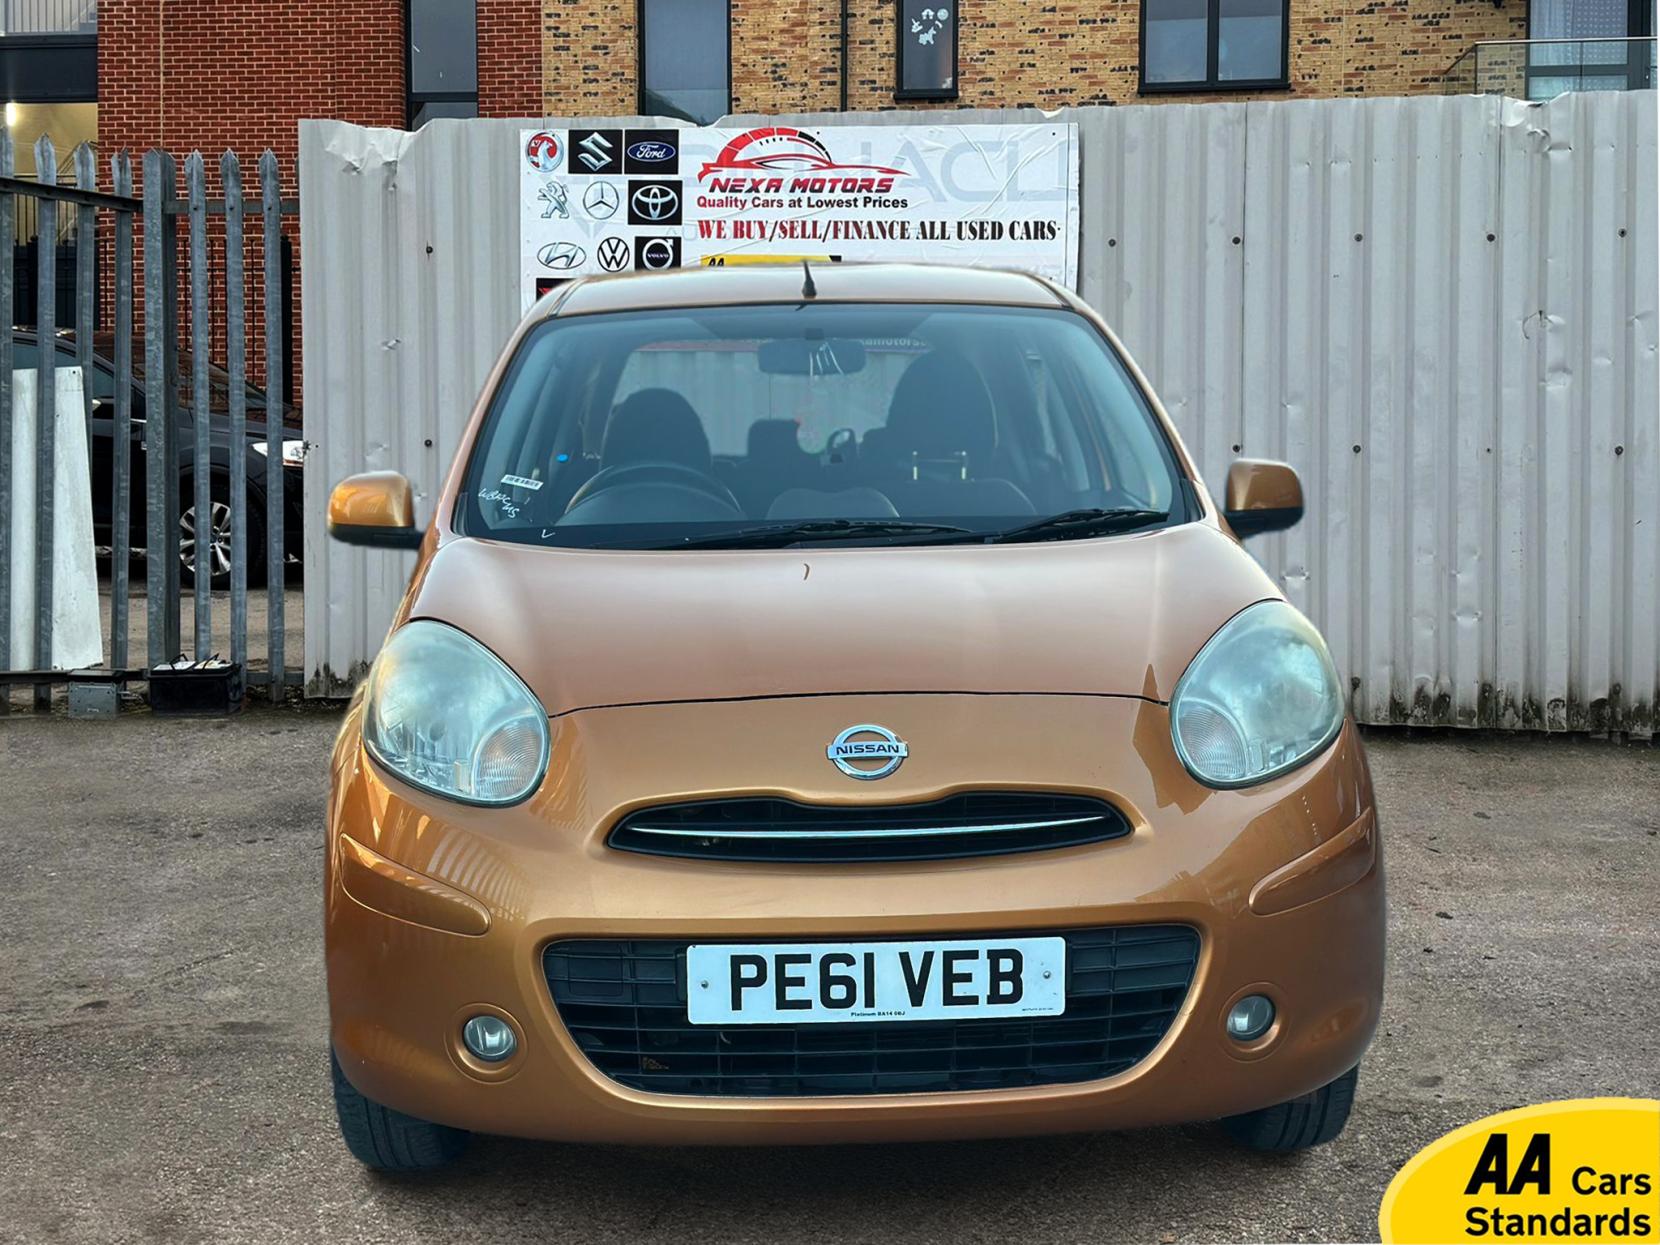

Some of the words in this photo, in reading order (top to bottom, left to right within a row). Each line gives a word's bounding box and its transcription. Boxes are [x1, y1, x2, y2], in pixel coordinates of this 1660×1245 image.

[634, 143, 668, 160] Ford
[708, 178, 783, 193] NEXA
[789, 177, 894, 193] MOTORS
[697, 196, 747, 211] Quality
[752, 196, 784, 209] Cars
[788, 196, 803, 208] at
[807, 196, 858, 209] Lowest
[863, 196, 908, 209] Prices
[697, 220, 727, 240] WE
[733, 219, 911, 243] BUY/SELL/FINANCE
[916, 220, 951, 240] ALL
[957, 220, 1004, 240] USED
[1009, 220, 1057, 240] CARS
[836, 744, 900, 755] NISSAN
[730, 952, 875, 1011] PE61
[898, 948, 1024, 1007] VEB
